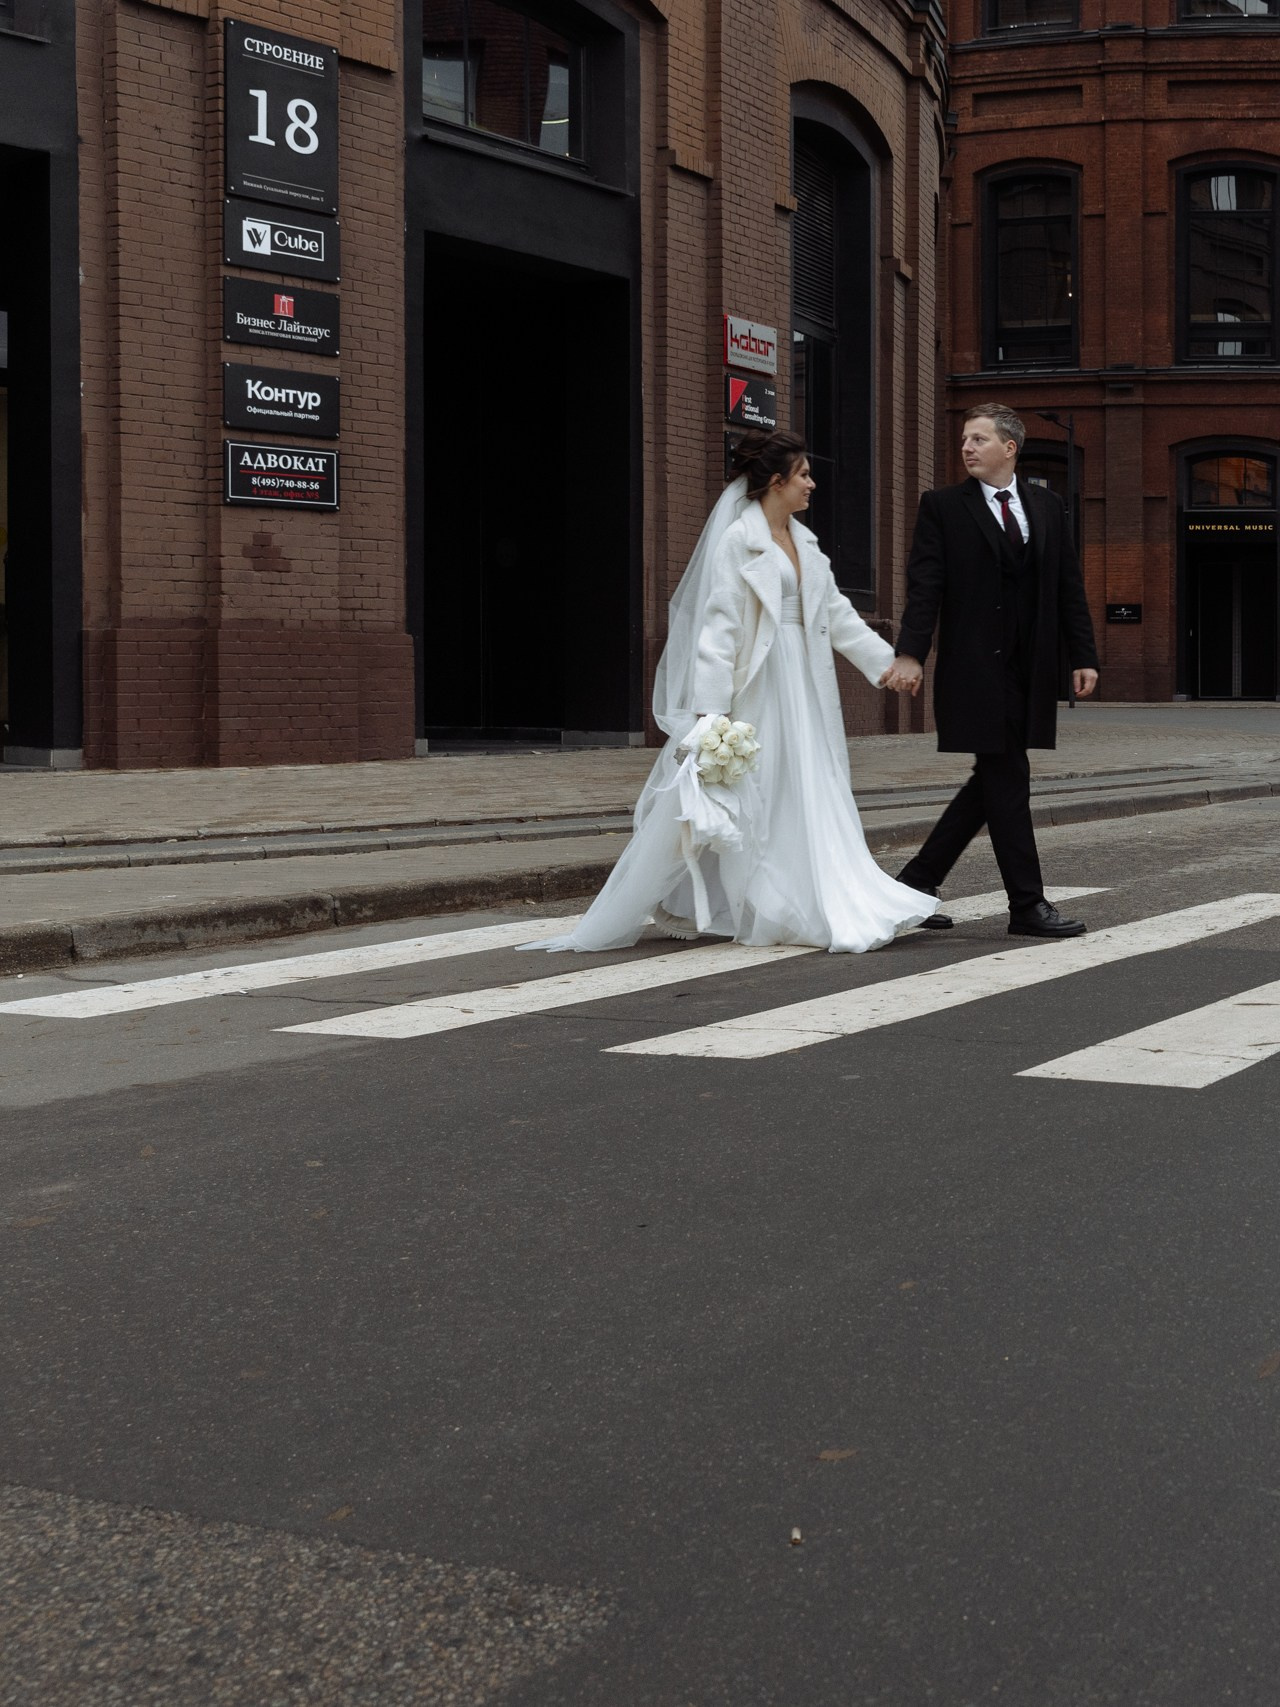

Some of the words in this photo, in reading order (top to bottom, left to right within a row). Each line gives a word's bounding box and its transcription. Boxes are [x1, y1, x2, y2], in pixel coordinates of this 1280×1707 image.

[244, 37, 324, 70] СТРОЕНИЕ
[248, 88, 319, 154] 18
[274, 230, 319, 253] Cube
[236, 312, 276, 330] Бизнес
[278, 319, 331, 339] Лайтхаус
[249, 328, 292, 339] консалтинговая
[292, 335, 318, 343] компания
[246, 379, 321, 410] Контур
[246, 405, 293, 418] Официальный
[294, 412, 320, 421] партнер
[239, 451, 327, 473] АДВОКАТ
[251, 476, 320, 490] 8(495)740-88-56
